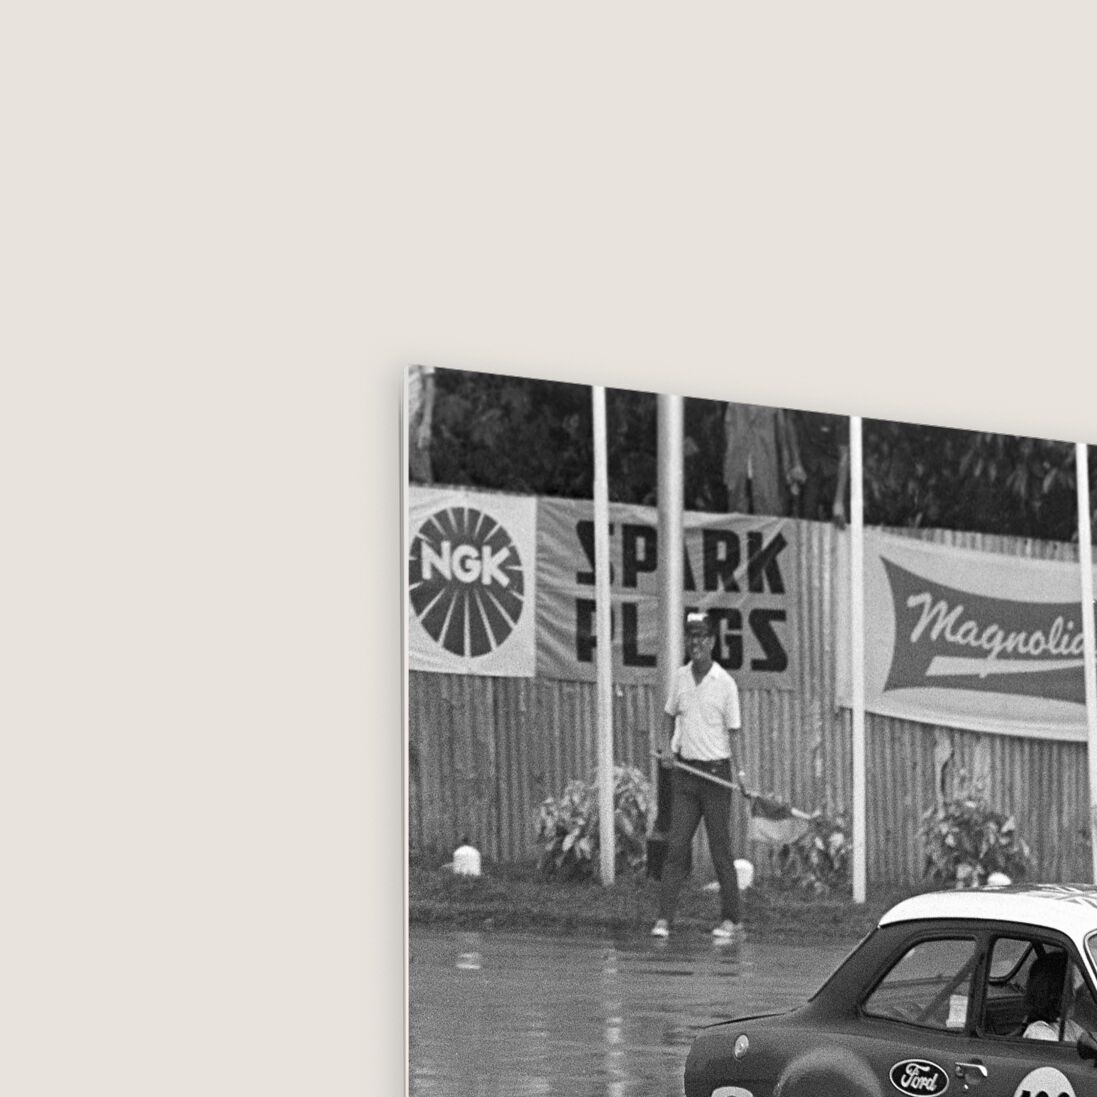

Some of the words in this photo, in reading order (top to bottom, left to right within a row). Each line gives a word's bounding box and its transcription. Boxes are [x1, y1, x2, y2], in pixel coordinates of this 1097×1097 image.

[421, 540, 510, 587] NGK
[576, 598, 788, 672] PLGS
[901, 1063, 939, 1092] Ford
